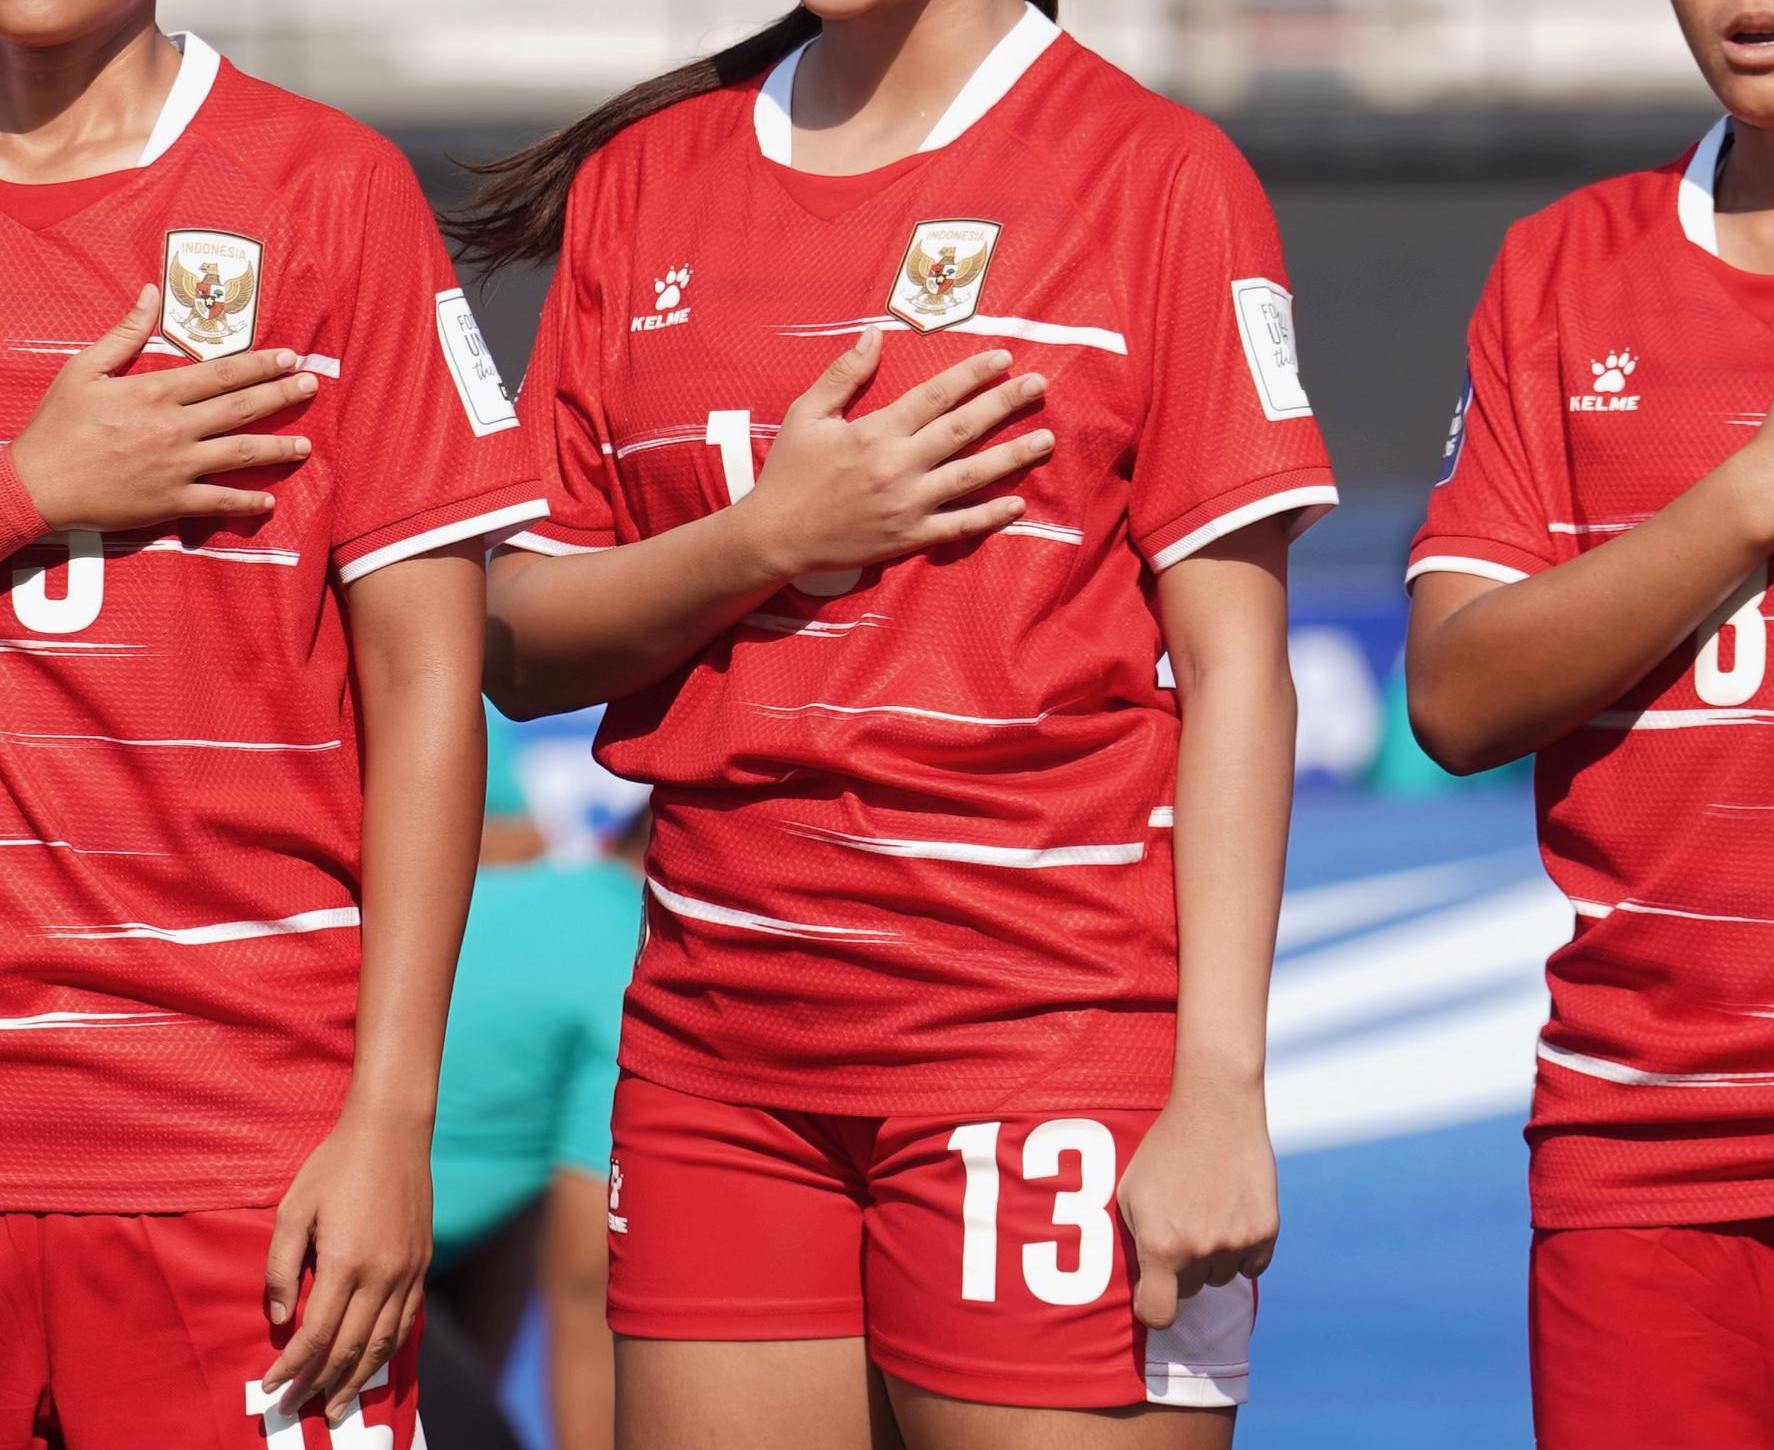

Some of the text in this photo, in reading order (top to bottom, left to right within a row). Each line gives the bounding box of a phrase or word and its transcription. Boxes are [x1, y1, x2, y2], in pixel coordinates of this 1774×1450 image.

[927, 229, 985, 242] INDONESIA
[181, 240, 247, 260] INDONESIA
[630, 307, 691, 332] KELME
[1569, 395, 1641, 412] KELME
[947, 1118, 1116, 1306] 13
